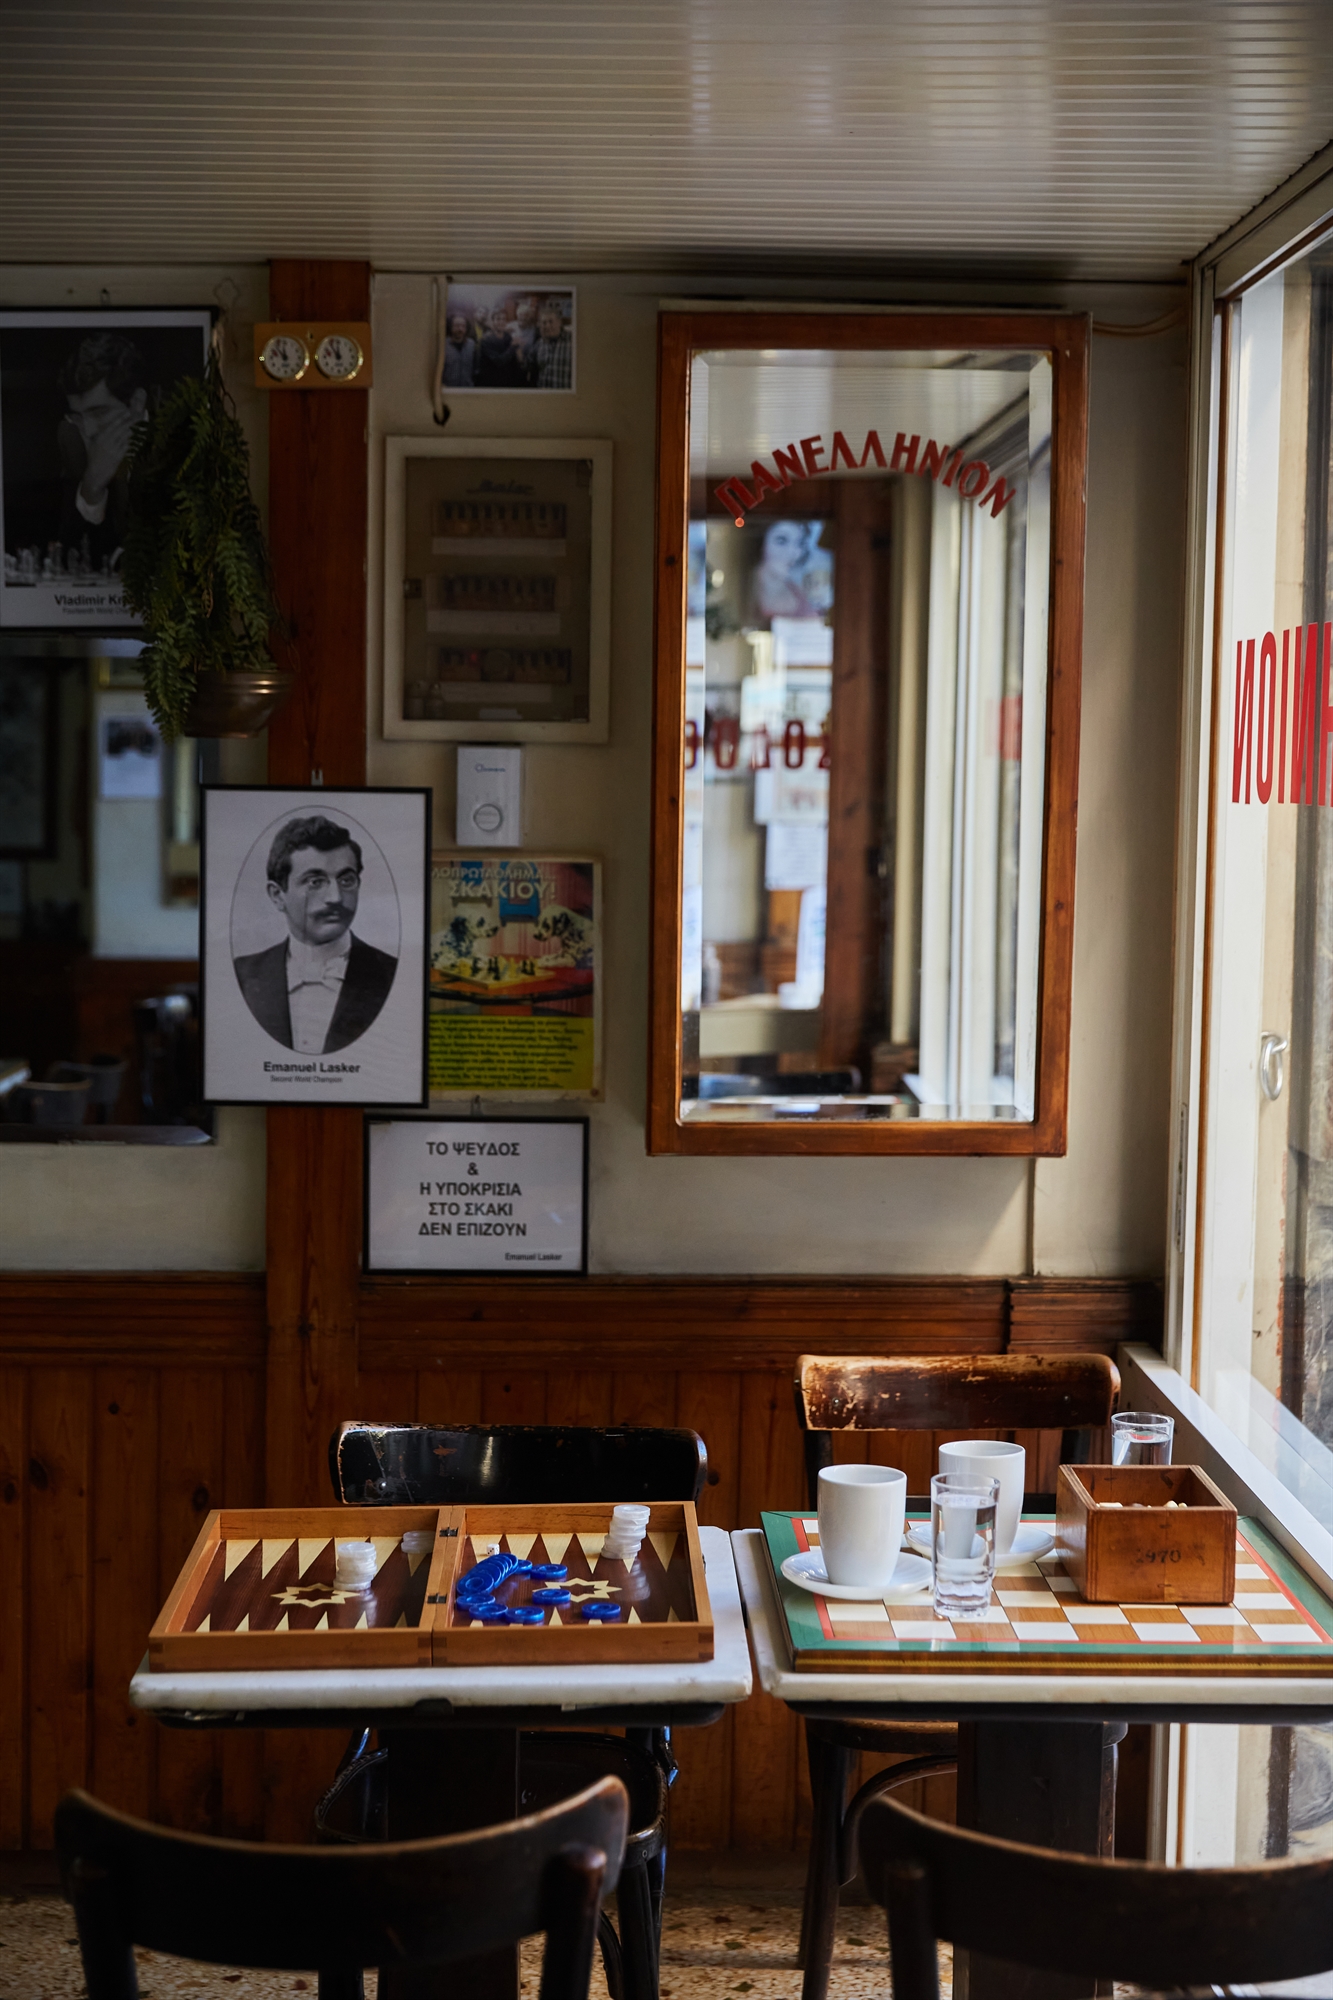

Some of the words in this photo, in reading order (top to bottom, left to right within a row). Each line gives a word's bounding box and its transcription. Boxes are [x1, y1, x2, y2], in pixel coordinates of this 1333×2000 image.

[714, 430, 1018, 519] ΠΑΝΕΛΛΗΝΙΟΝ
[54, 594, 106, 606] Vladimir
[449, 880, 557, 899] ΣΚΑΚΙΟΥ!
[263, 1061, 317, 1073] Emanuel
[319, 1062, 361, 1073] Lasker
[426, 1142, 448, 1155] ΤΟ
[453, 1142, 520, 1156] ΨΕΥΔΟΣ
[467, 1162, 479, 1176] &
[420, 1182, 430, 1195] Η
[435, 1182, 522, 1196] ΥΠΟΚΡΙΣΙΑ
[428, 1202, 460, 1216] ΣΤΟ
[464, 1202, 513, 1216] ΣΚΑΚΙ
[418, 1222, 452, 1236] ΔΕΝ
[457, 1222, 527, 1236] ΕΠΙΖΟΥΝ
[505, 1252, 536, 1261] Emanuel
[537, 1253, 562, 1261] Lasker
